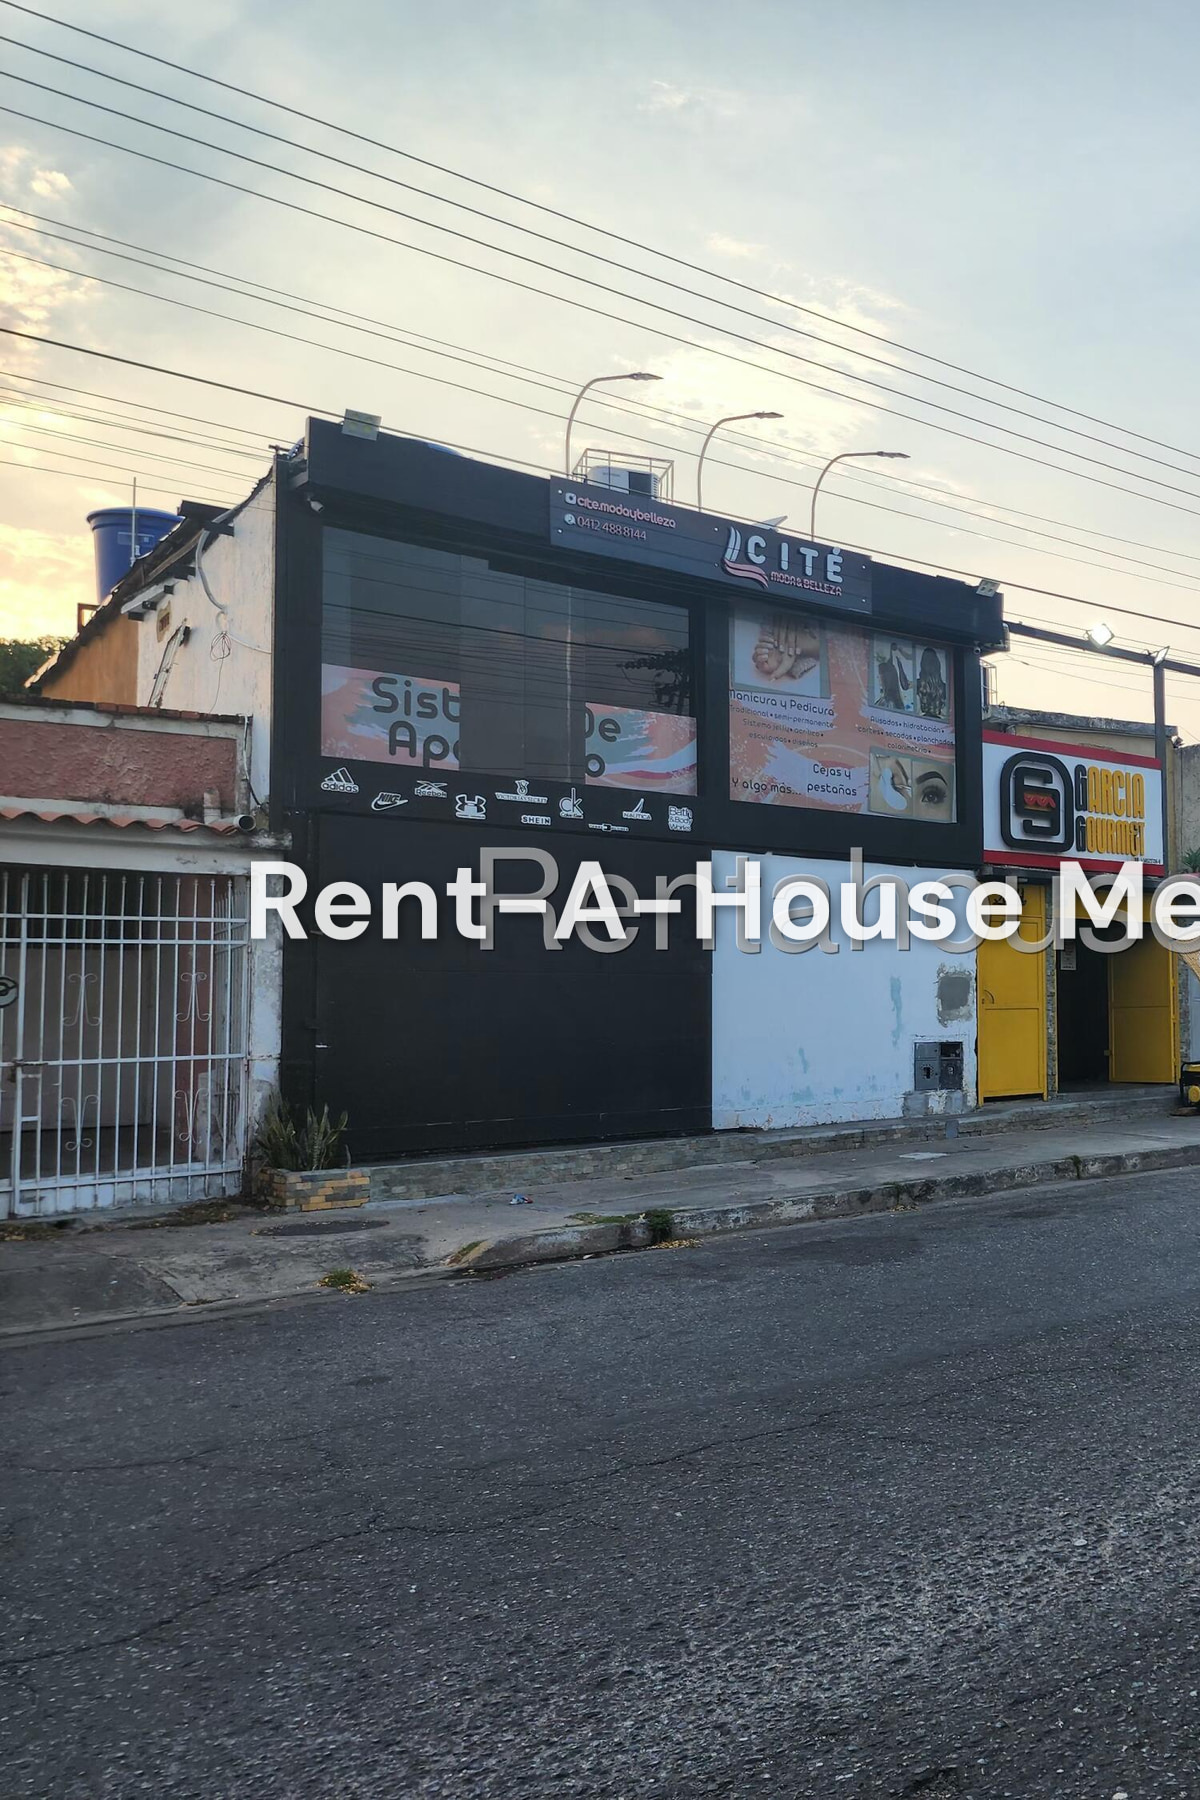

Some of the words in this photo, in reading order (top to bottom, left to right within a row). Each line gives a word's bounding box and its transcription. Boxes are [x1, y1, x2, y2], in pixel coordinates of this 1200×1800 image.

[577, 495, 676, 529] cite.modaybelleza
[577, 515, 600, 531] 0412
[602, 522, 622, 535] 488
[623, 526, 646, 541] 8144
[747, 535, 843, 583] CITÉ
[780, 700, 787, 709] y
[790, 699, 835, 716] Pedicura
[388, 720, 460, 768] Ap
[813, 764, 841, 777] Cejas
[844, 770, 851, 780] y
[321, 782, 358, 793] adidas
[415, 788, 447, 798] Reebok
[742, 779, 768, 793] algo
[807, 782, 857, 796] pestañas
[1074, 764, 1145, 819] GARCIA
[380, 793, 400, 804] NIKE
[623, 811, 651, 820] NAUTICA
[669, 806, 692, 818] Bath
[522, 816, 550, 825] SHEIN
[1075, 815, 1145, 857] GOURMET
